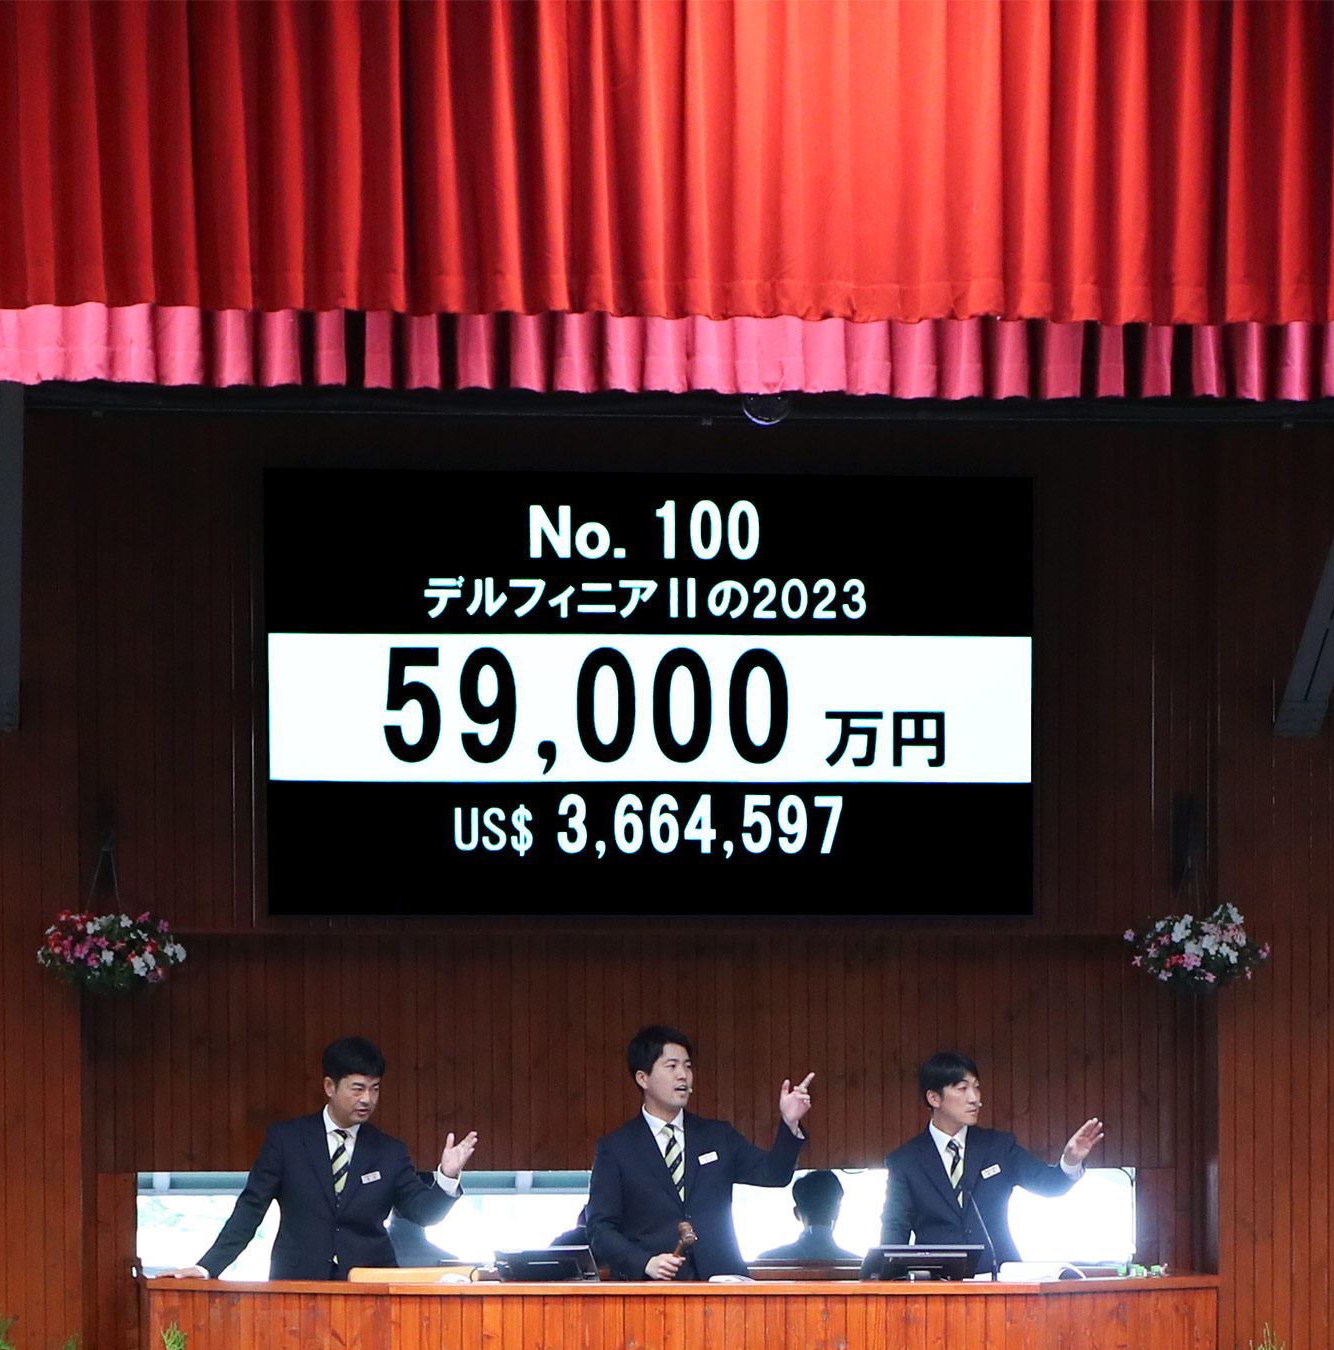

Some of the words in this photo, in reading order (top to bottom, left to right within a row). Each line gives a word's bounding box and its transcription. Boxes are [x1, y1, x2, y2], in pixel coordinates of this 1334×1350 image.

[529, 504, 626, 560] No.
[655, 499, 760, 561] 100
[383, 646, 789, 775] 59,000
[824, 711, 946, 768] 万円
[454, 803, 534, 857] US$
[557, 793, 844, 860] 3,664,597
